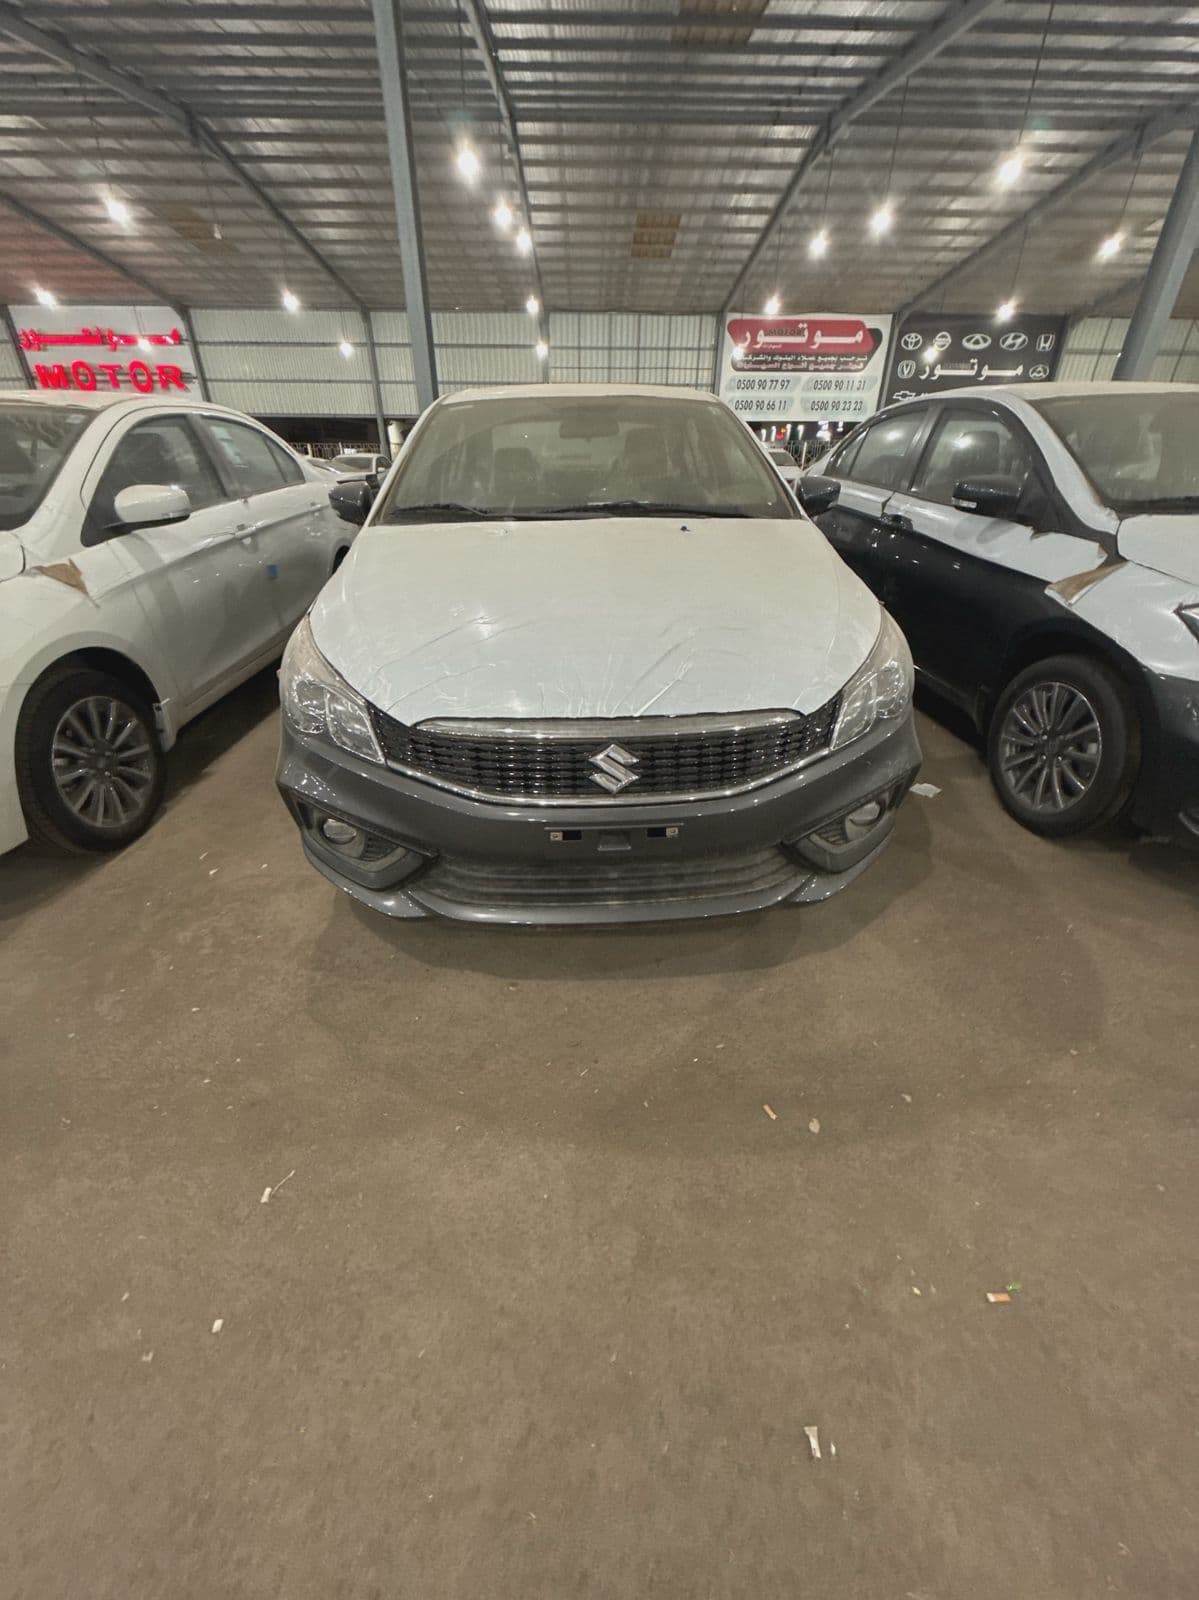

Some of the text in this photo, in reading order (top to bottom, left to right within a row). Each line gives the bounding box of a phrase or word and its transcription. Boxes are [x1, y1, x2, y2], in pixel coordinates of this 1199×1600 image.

[738, 323, 864, 349] موتور
[919, 358, 1024, 381] موتور
[35, 359, 188, 393] MOTOR
[736, 379, 791, 390] 0500 90 77 97
[813, 380, 866, 390] 0500 90 11 31
[735, 400, 787, 410] 0500 90 66 11
[811, 400, 863, 411] 0500 90 23 23
